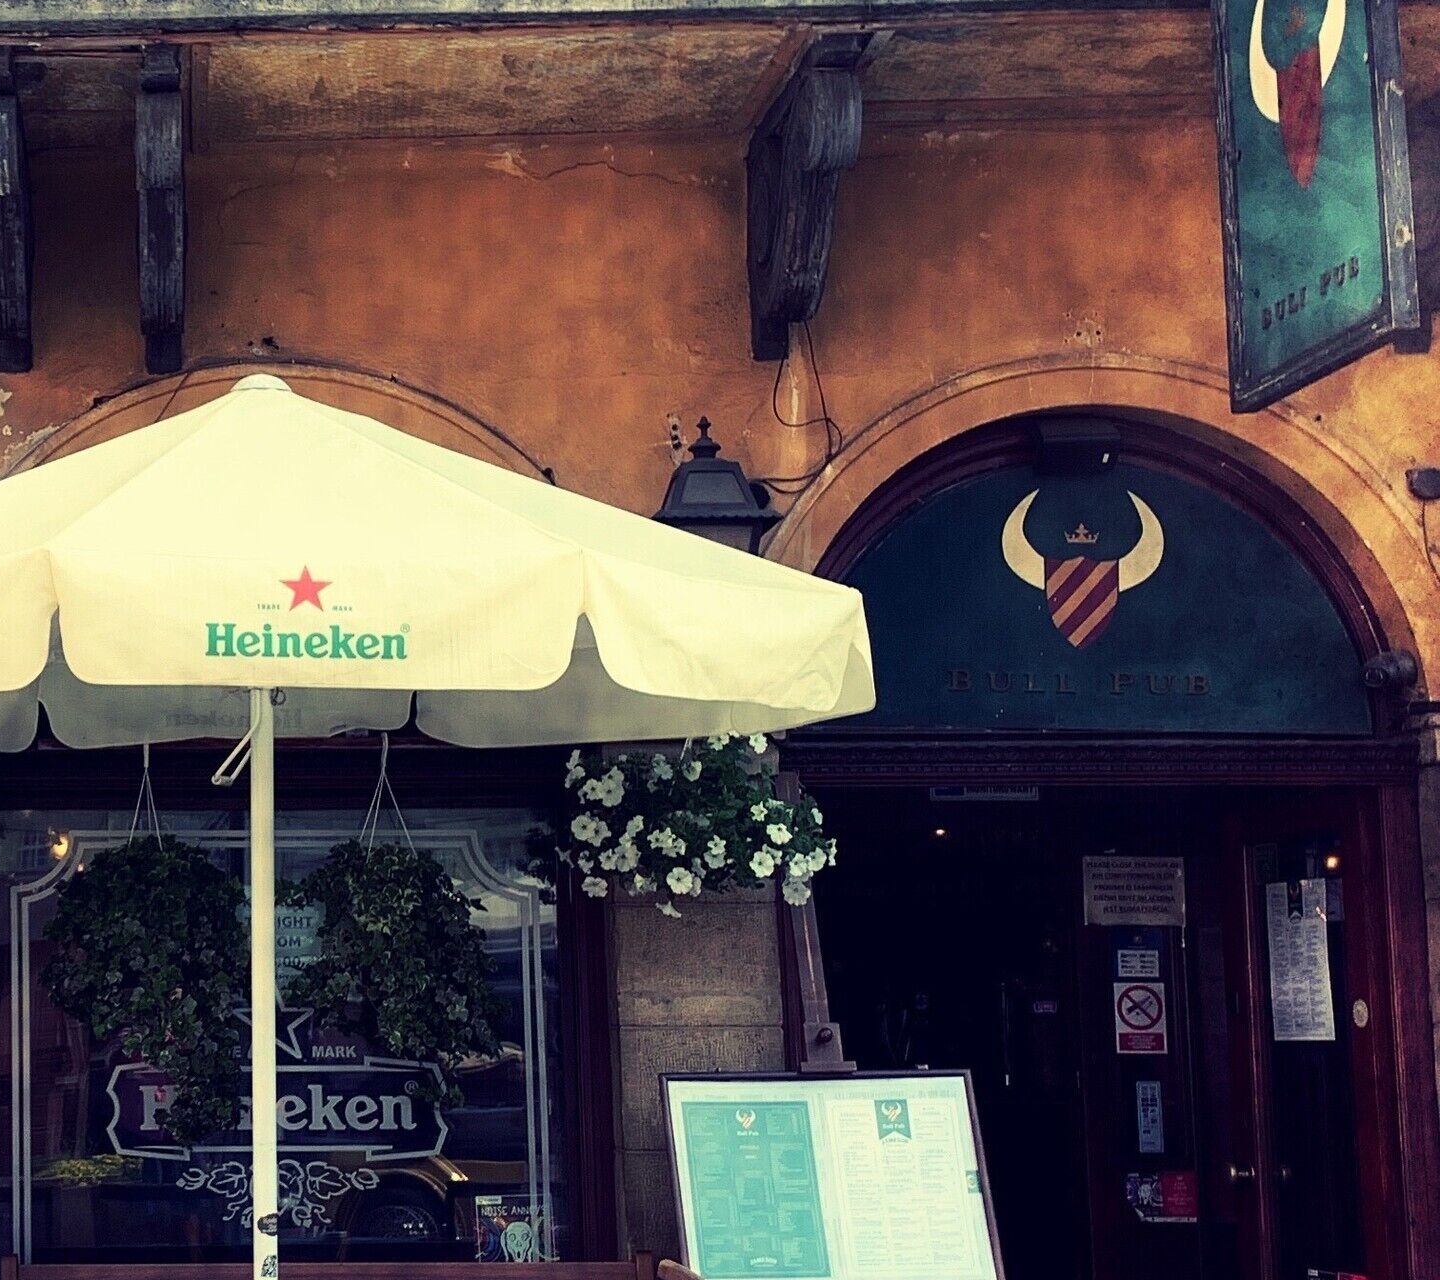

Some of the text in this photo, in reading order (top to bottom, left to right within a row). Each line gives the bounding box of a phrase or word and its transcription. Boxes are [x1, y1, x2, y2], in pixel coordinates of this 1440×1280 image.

[205, 622, 408, 660] Heineken
[947, 670, 1210, 696] BULL PUB
[312, 1045, 356, 1058] MARK
[481, 1206, 507, 1216] NOISE
